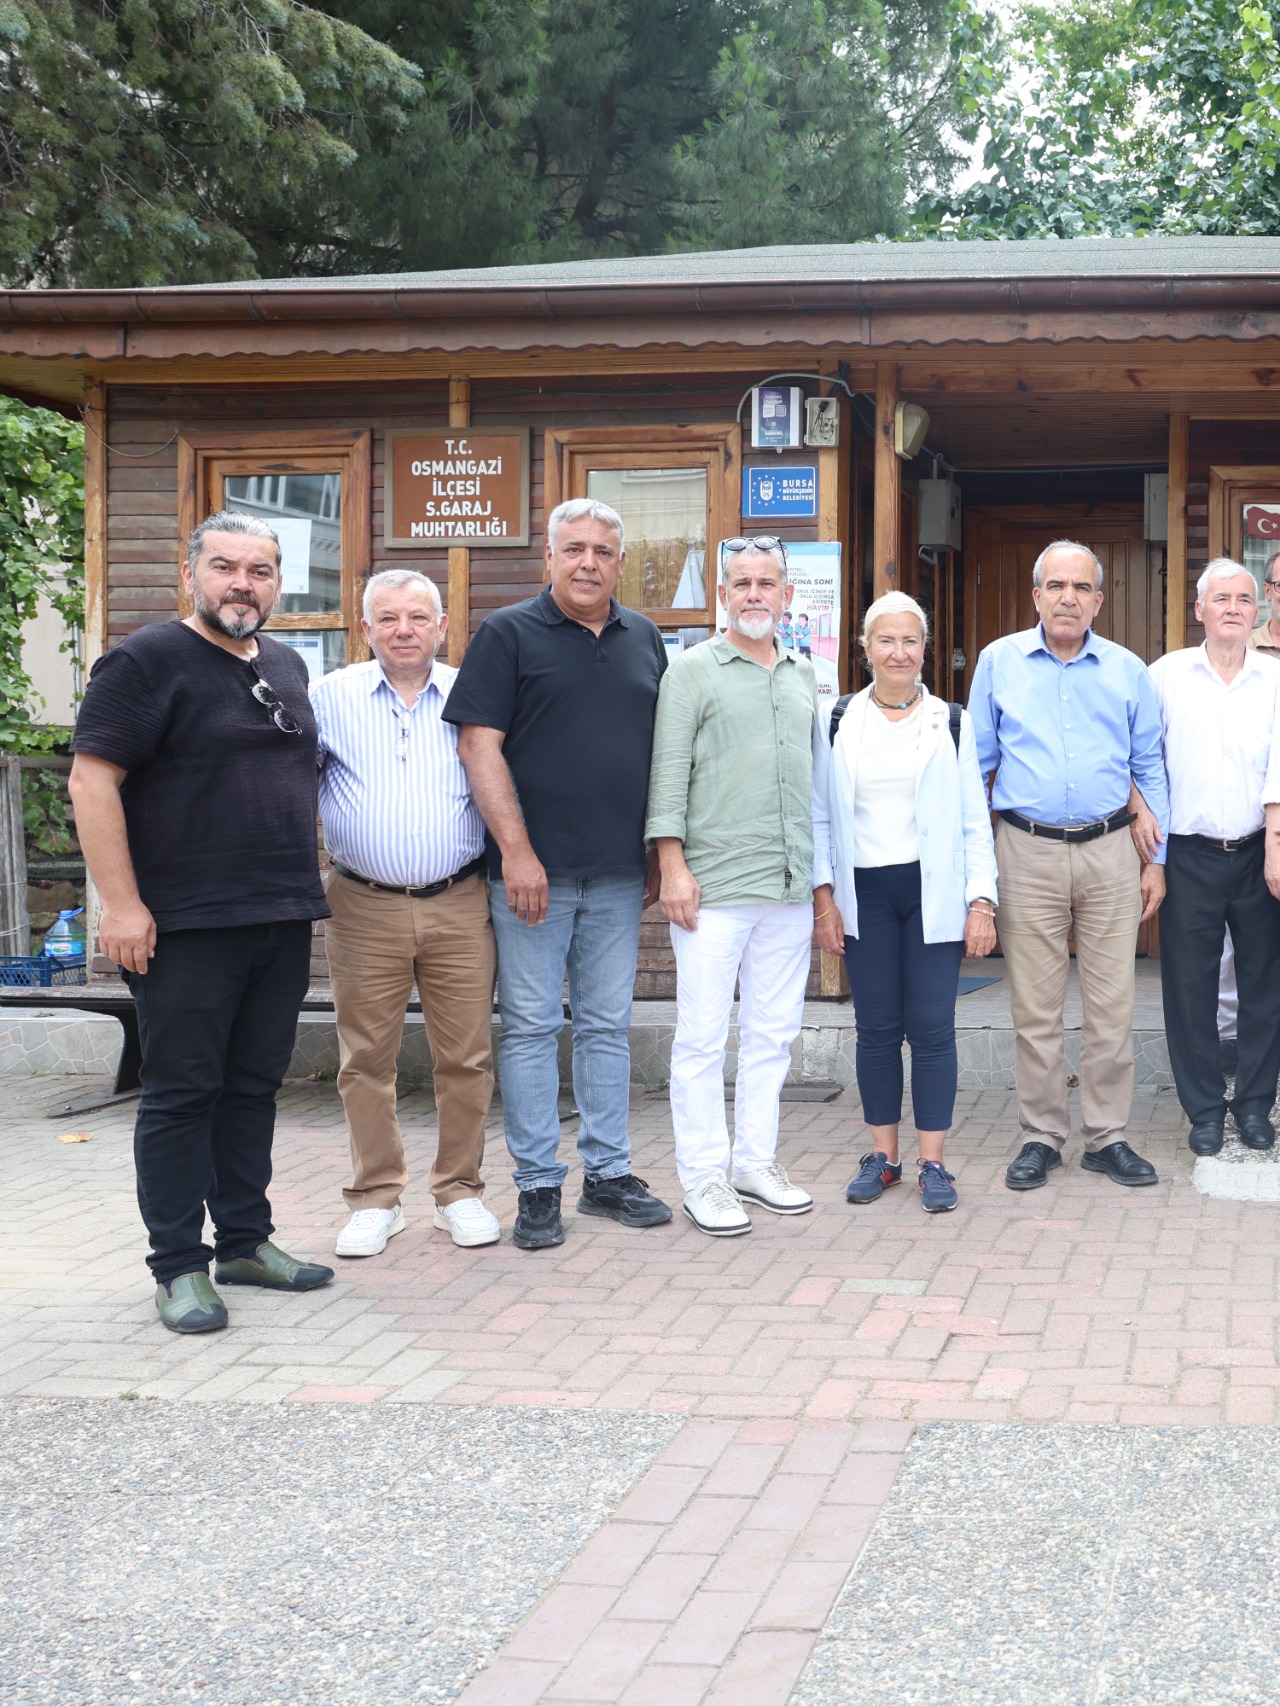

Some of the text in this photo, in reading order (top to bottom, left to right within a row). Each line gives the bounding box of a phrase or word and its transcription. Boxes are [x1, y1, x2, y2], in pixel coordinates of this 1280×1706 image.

[445, 440, 473, 455] T.C.
[411, 456, 502, 476] OSMANGAZİ
[432, 477, 481, 500] İLÇESİ
[782, 479, 813, 488] BURSA
[425, 500, 492, 516] S.GARAJ
[411, 517, 507, 537] MUHTARLIĞI
